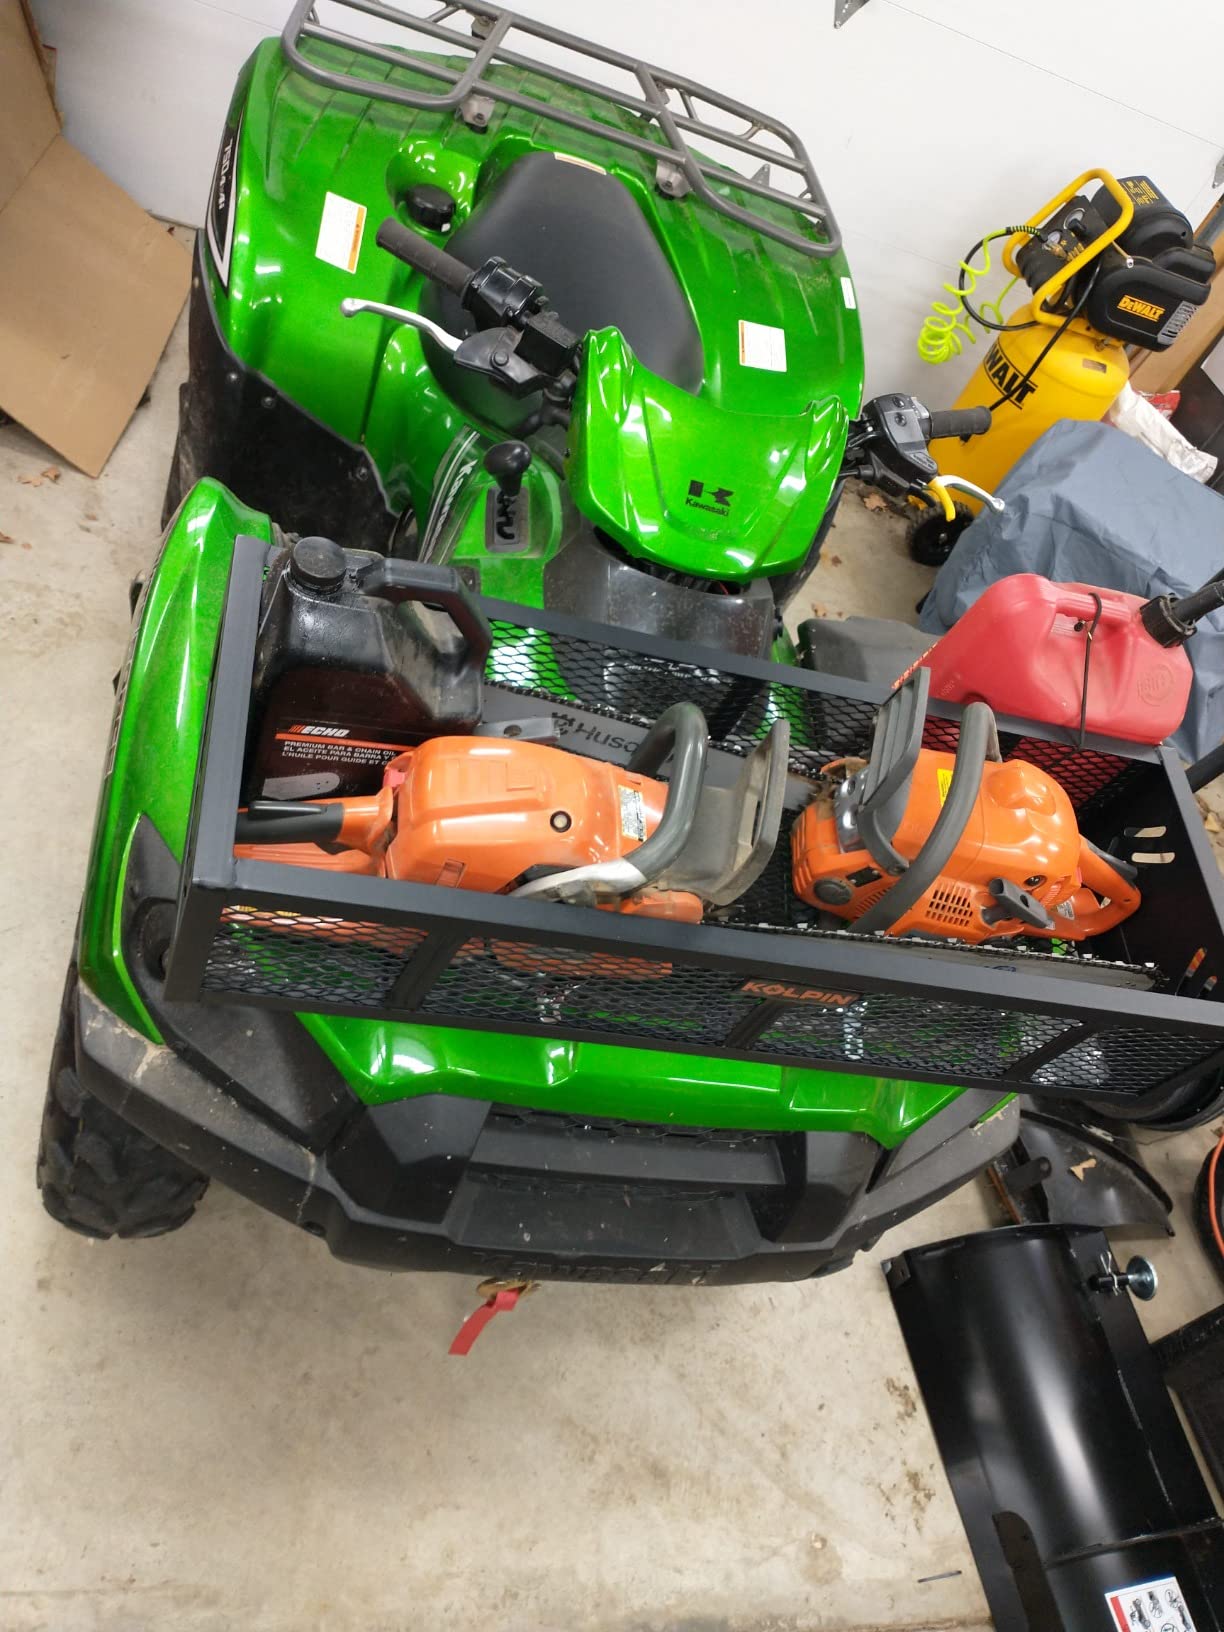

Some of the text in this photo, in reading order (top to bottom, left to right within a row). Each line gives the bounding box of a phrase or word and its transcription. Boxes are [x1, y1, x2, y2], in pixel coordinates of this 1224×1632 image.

[685, 498, 729, 516] Kawasaki
[301, 725, 350, 738] ECHO
[284, 740, 326, 749] PREMIUM
[354, 747, 382, 755] CHAIN
[296, 747, 328, 755] ACEITE
[329, 749, 352, 757] PARA
[353, 752, 382, 760] BARRA
[281, 750, 314, 759] L'HUILE
[340, 756, 368, 765] GUIDE
[741, 981, 853, 1005] KOLPIN
